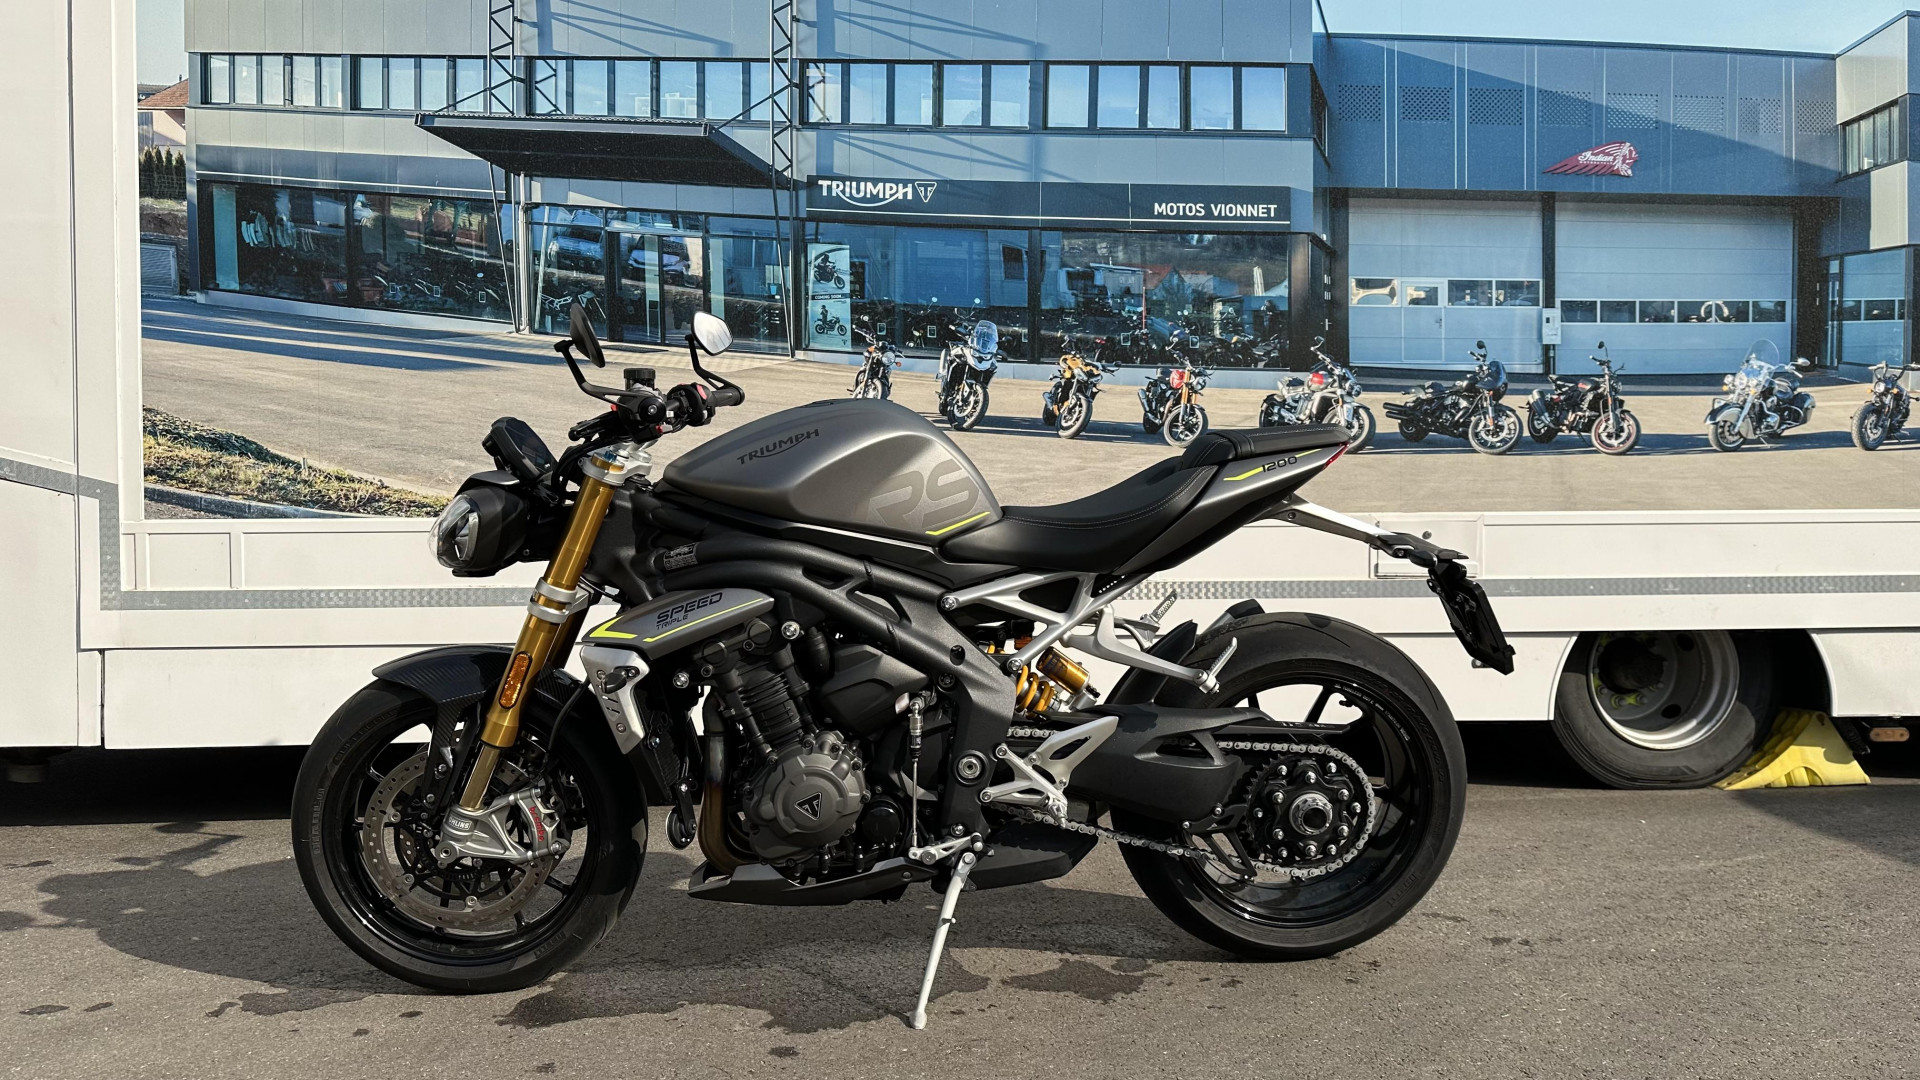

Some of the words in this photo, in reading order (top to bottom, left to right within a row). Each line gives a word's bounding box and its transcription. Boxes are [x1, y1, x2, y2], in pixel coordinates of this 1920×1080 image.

[1578, 151, 1614, 161] Indian
[818, 180, 913, 206] TRIUMPH
[1154, 203, 1205, 216] MOTOS
[1210, 204, 1278, 217] VIONNET
[737, 429, 820, 465] TRIUMPH
[1262, 456, 1298, 472] 1200
[866, 459, 980, 529] RS
[656, 592, 723, 624] SPEED
[656, 614, 689, 630] TRIPLE
